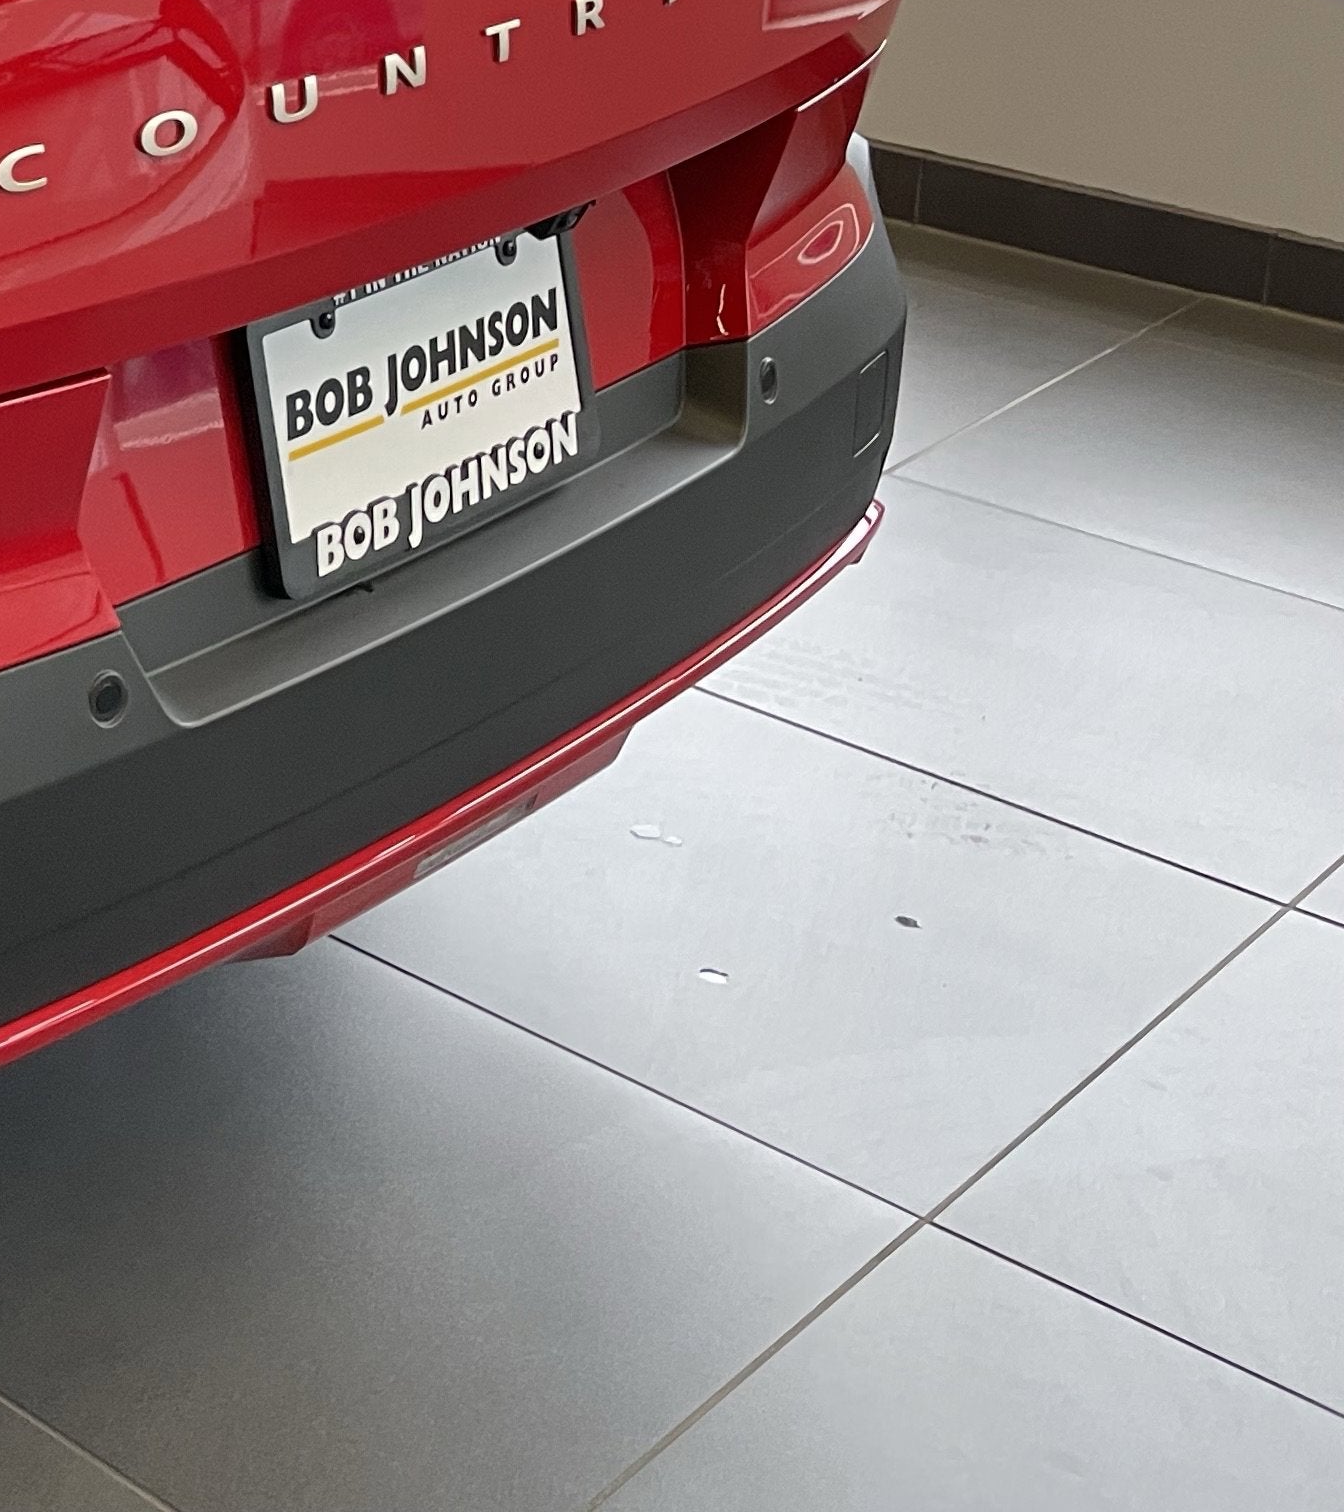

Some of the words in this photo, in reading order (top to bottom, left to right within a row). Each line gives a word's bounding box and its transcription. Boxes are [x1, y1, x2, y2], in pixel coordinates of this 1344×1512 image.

[286, 365, 374, 441] BOB
[384, 287, 559, 417] JOHNSON
[420, 389, 479, 430] AUTO
[491, 353, 560, 397] GROUP
[314, 496, 401, 577] BOB
[408, 411, 580, 550] JOHNSON
